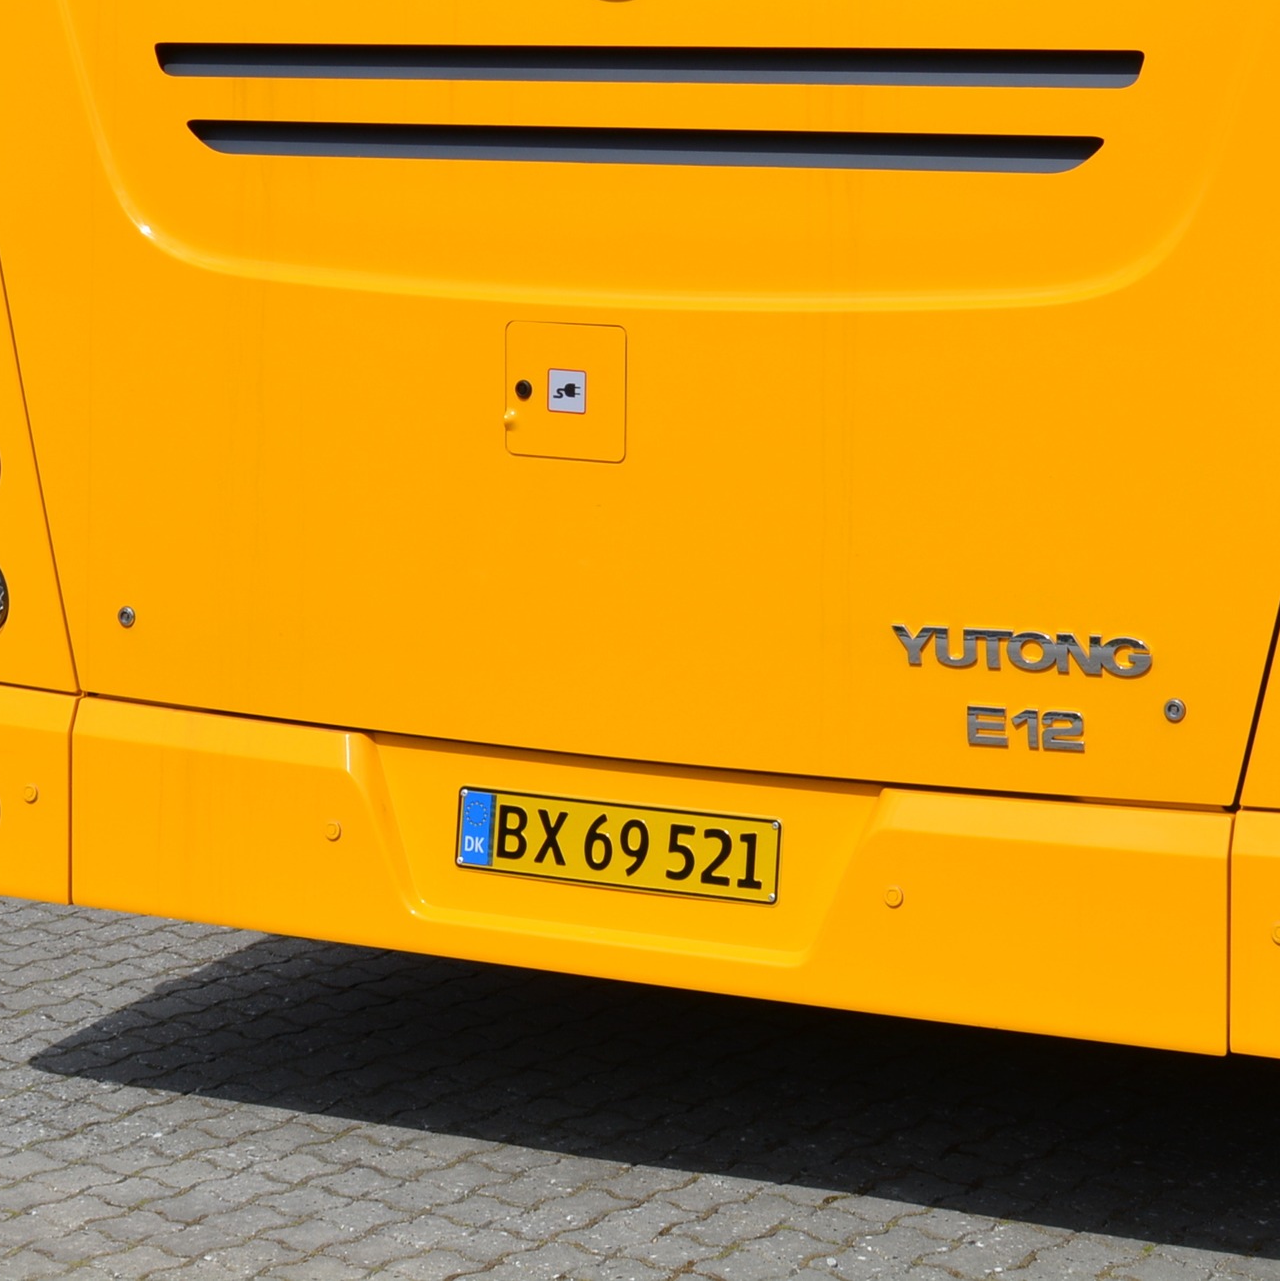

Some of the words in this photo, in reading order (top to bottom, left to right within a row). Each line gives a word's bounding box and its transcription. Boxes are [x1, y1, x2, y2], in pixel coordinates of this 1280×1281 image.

[891, 623, 1153, 679] YUTONG
[966, 704, 1085, 754] E12
[464, 835, 485, 854] DK
[495, 804, 569, 866] BX
[584, 813, 650, 877] 69
[665, 823, 762, 890] 521
